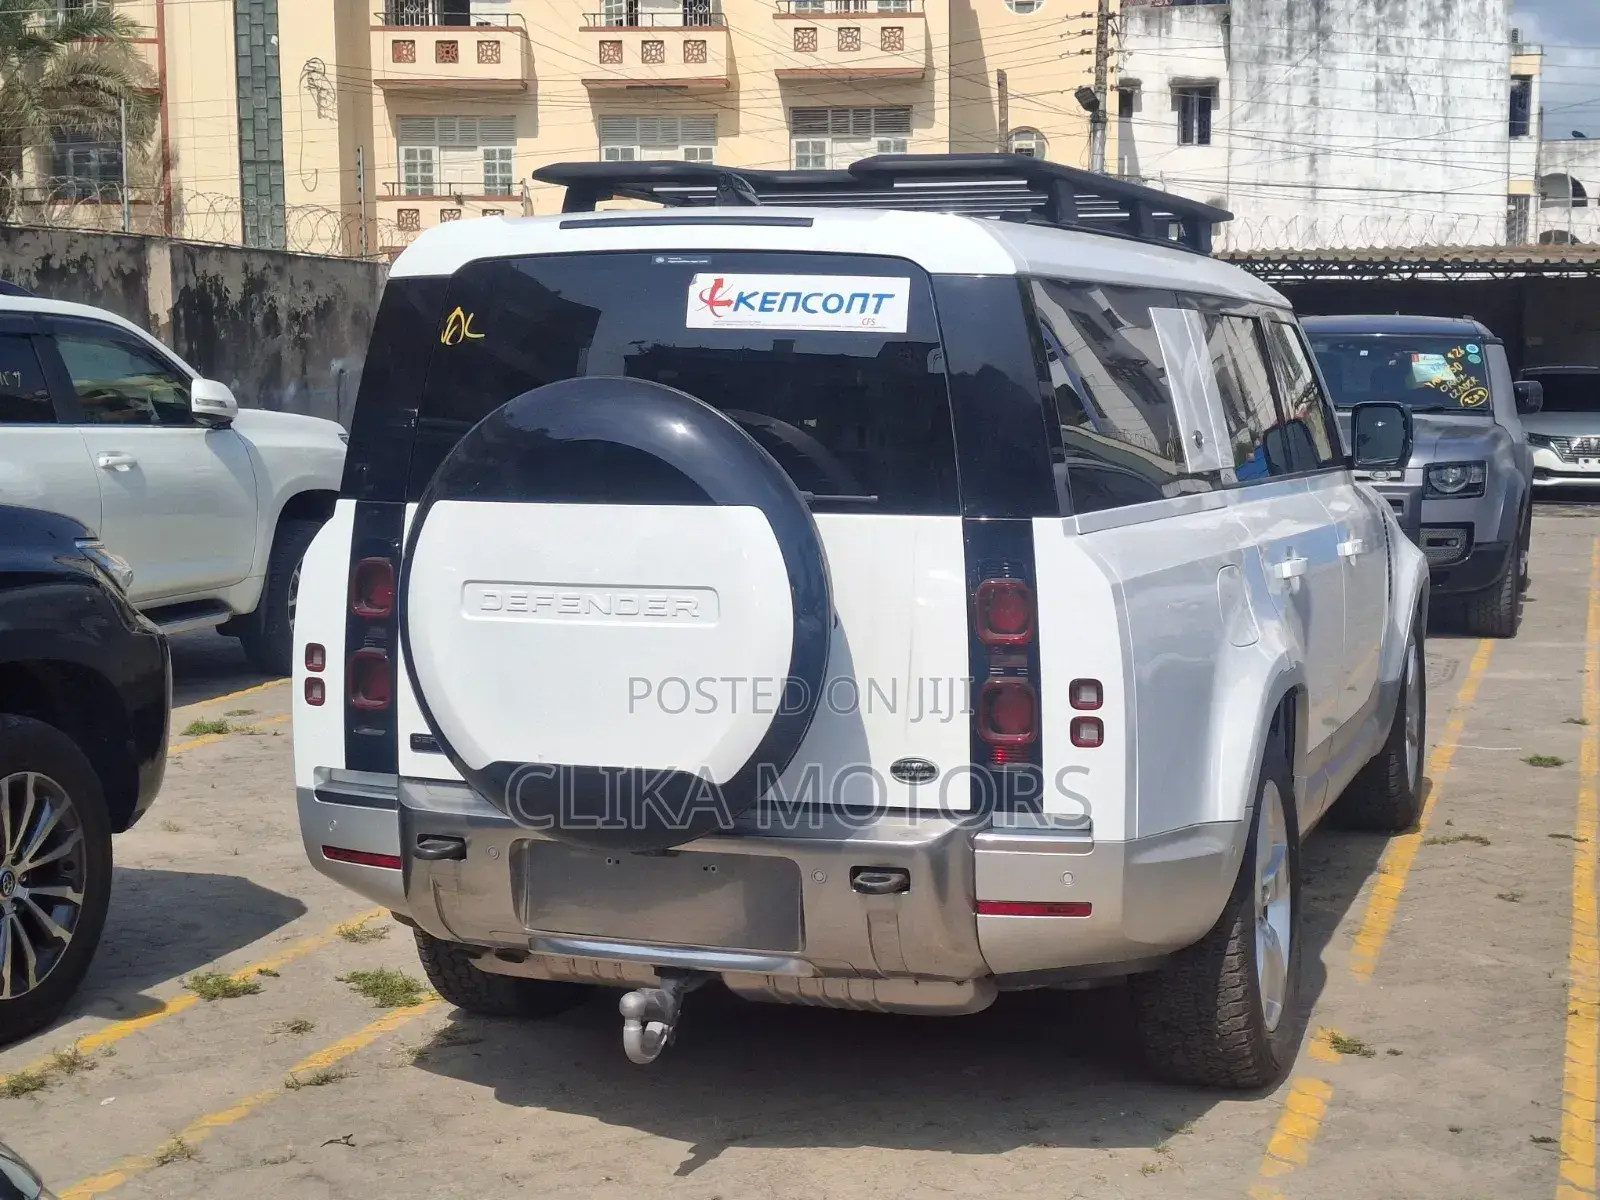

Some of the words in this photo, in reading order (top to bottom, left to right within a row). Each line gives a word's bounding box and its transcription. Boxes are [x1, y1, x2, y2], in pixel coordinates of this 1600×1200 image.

[861, 317, 876, 326] CFS
[479, 589, 700, 618] DEFENDER
[901, 762, 923, 770] LAND
